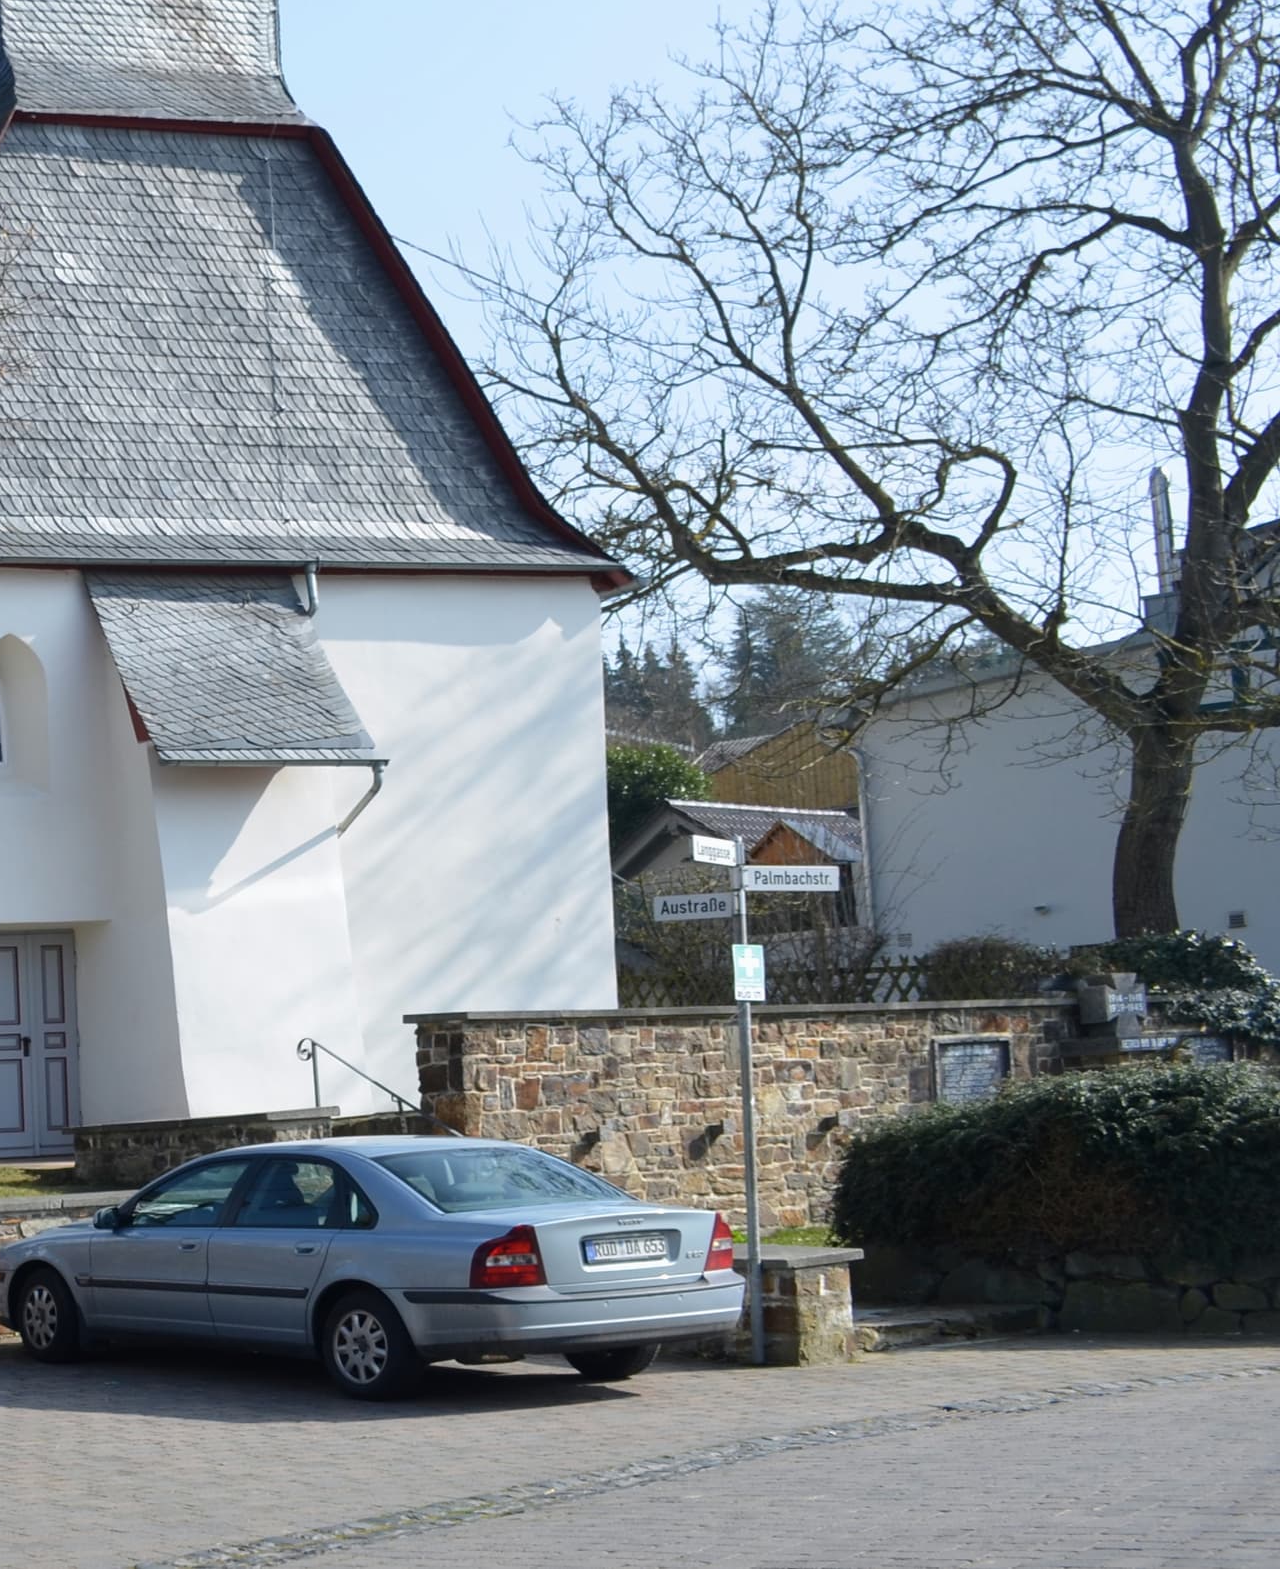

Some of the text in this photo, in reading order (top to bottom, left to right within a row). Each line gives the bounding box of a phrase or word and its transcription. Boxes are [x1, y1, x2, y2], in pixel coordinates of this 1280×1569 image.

[753, 870, 833, 886] Palmbachstr.
[660, 897, 727, 916] Austraße
[643, 1238, 665, 1254] 653
